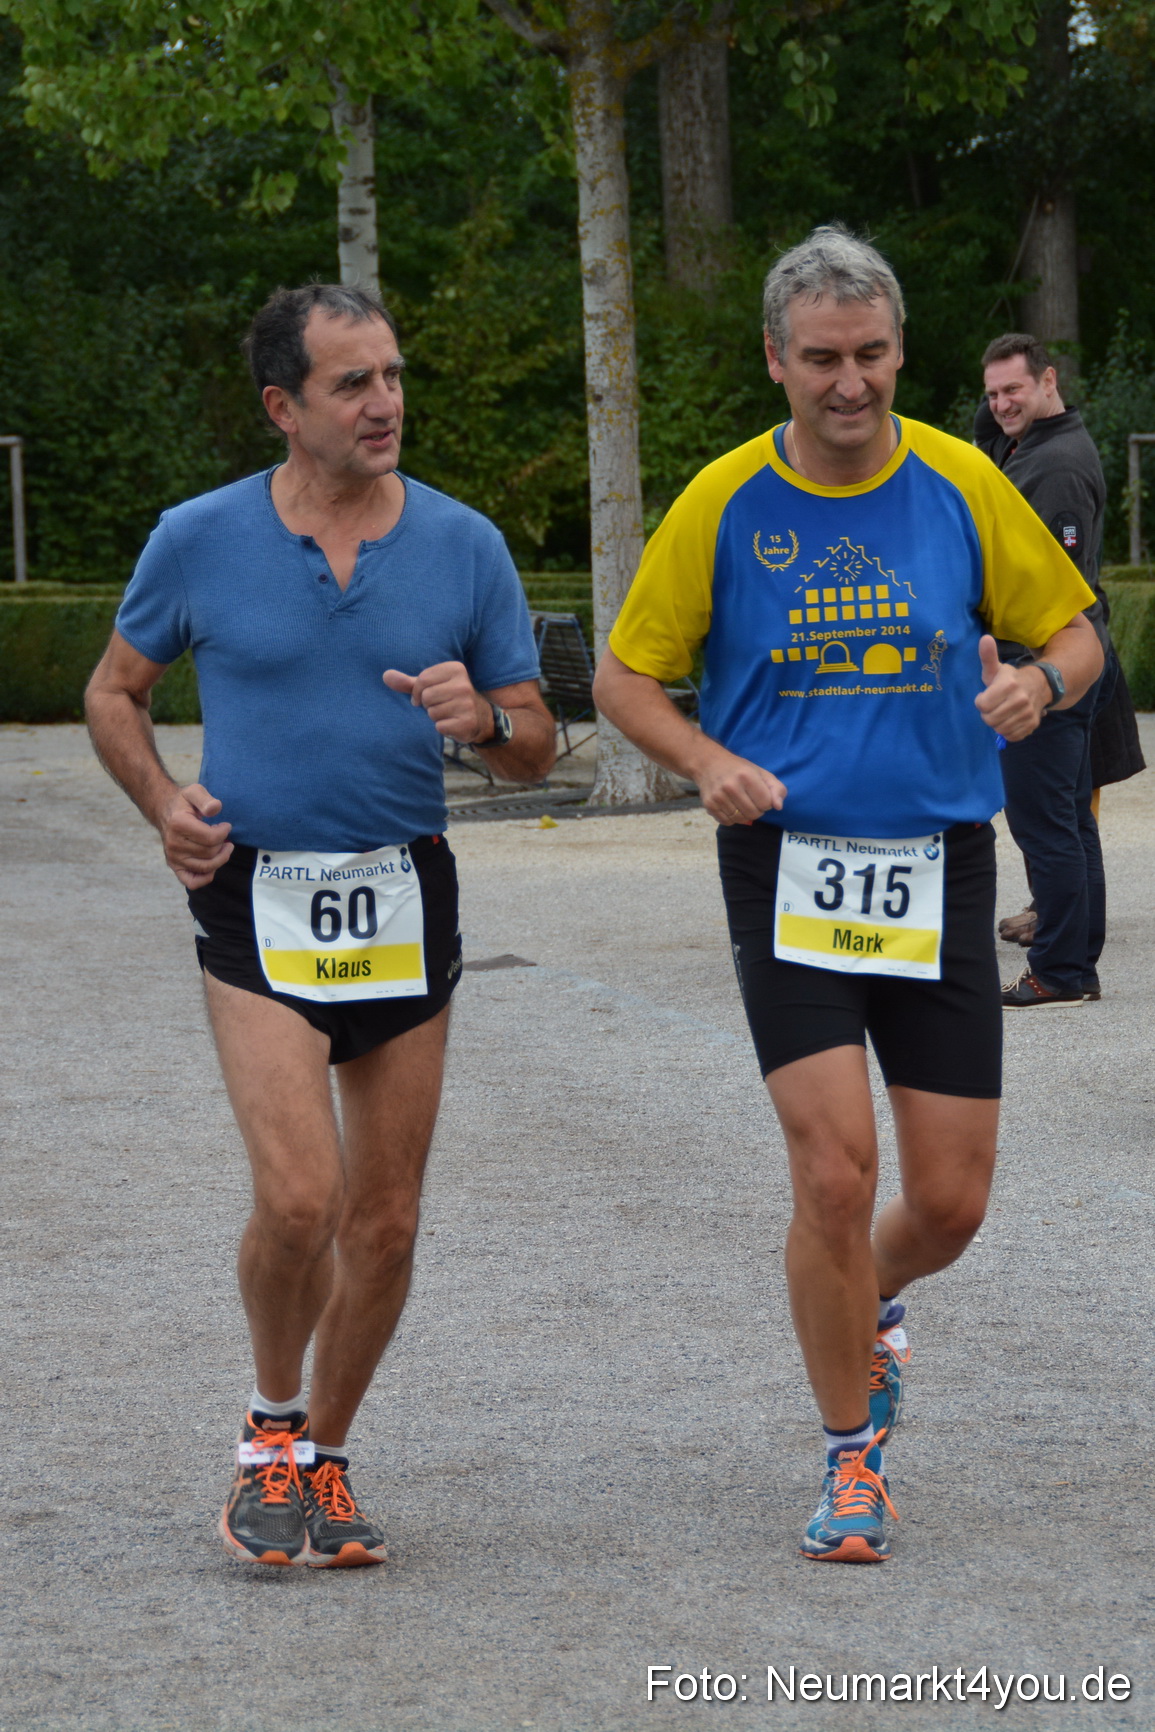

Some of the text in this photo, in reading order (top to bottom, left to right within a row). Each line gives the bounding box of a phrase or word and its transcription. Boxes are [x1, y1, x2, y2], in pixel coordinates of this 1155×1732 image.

[769, 535, 782, 543] 15
[763, 546, 789, 554] Jahre
[791, 625, 911, 642] 21.September 2014
[779, 683, 933, 698] www.stadtlauf-neumarkt.de
[786, 834, 918, 858] PARTL Neumarkt
[259, 861, 395, 882] PARTL Neumarkt
[814, 857, 913, 920] 315
[310, 885, 378, 943] 60
[783, 902, 790, 912] D
[264, 938, 272, 948] D
[832, 928, 885, 954] Mark
[315, 957, 372, 979] Klaus
